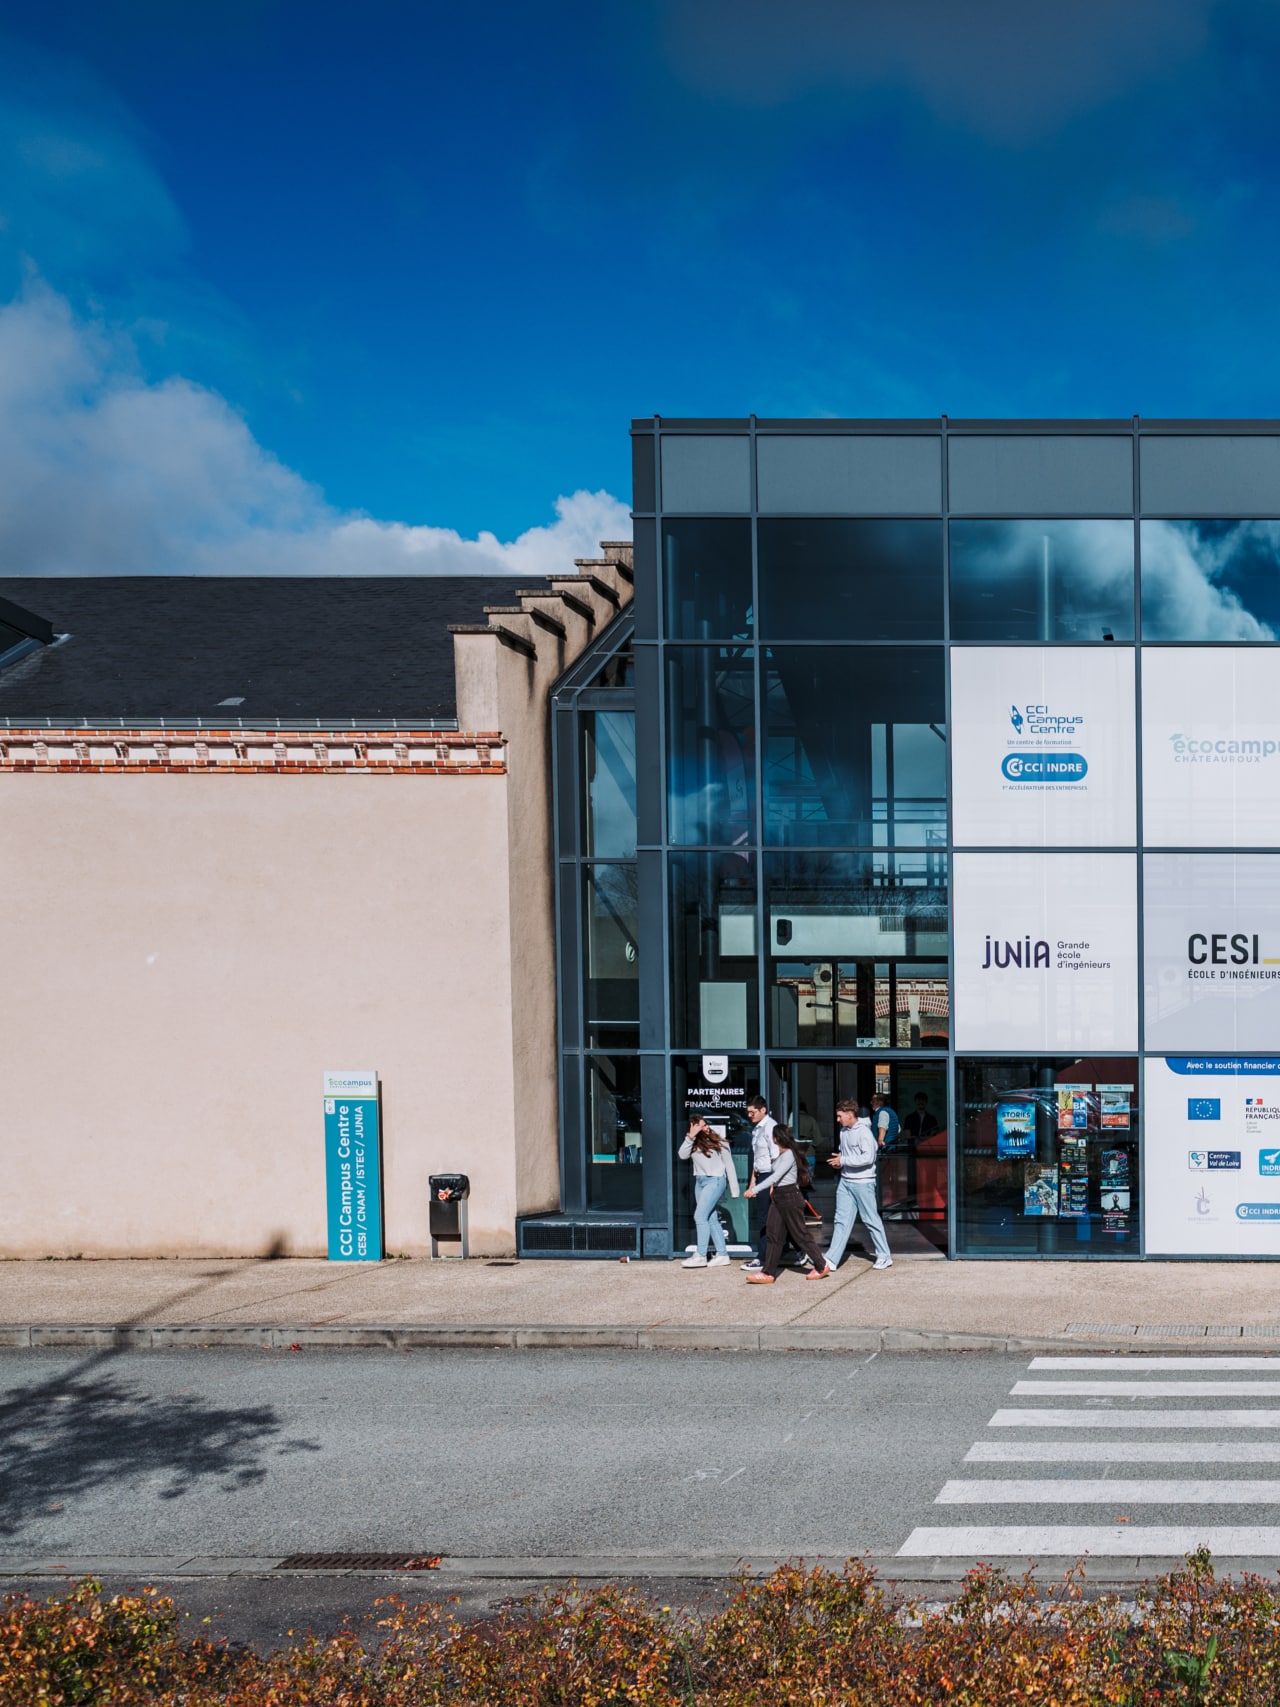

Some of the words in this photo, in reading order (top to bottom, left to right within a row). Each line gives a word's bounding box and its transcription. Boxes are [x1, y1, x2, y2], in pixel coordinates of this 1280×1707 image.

[1026, 706, 1048, 714] CCI
[1027, 715, 1084, 725] Campus
[1030, 725, 1075, 734] Centre
[1024, 763, 1043, 772] CCI
[1047, 763, 1082, 772] INDRE
[1057, 940, 1090, 949] Grande
[1057, 950, 1081, 959] école
[1188, 968, 1216, 979] ÉCOLE
[688, 1088, 744, 1096] PARTENAIRES
[1002, 1111, 1031, 1119] STORIES
[354, 1106, 364, 1138] JUNIA
[338, 1105, 350, 1158] Centre
[356, 1148, 365, 1178] ISTEC
[340, 1163, 354, 1226] Campus
[357, 1190, 366, 1222] CNAM
[340, 1229, 353, 1256] CCI
[358, 1232, 367, 1256] CESI
